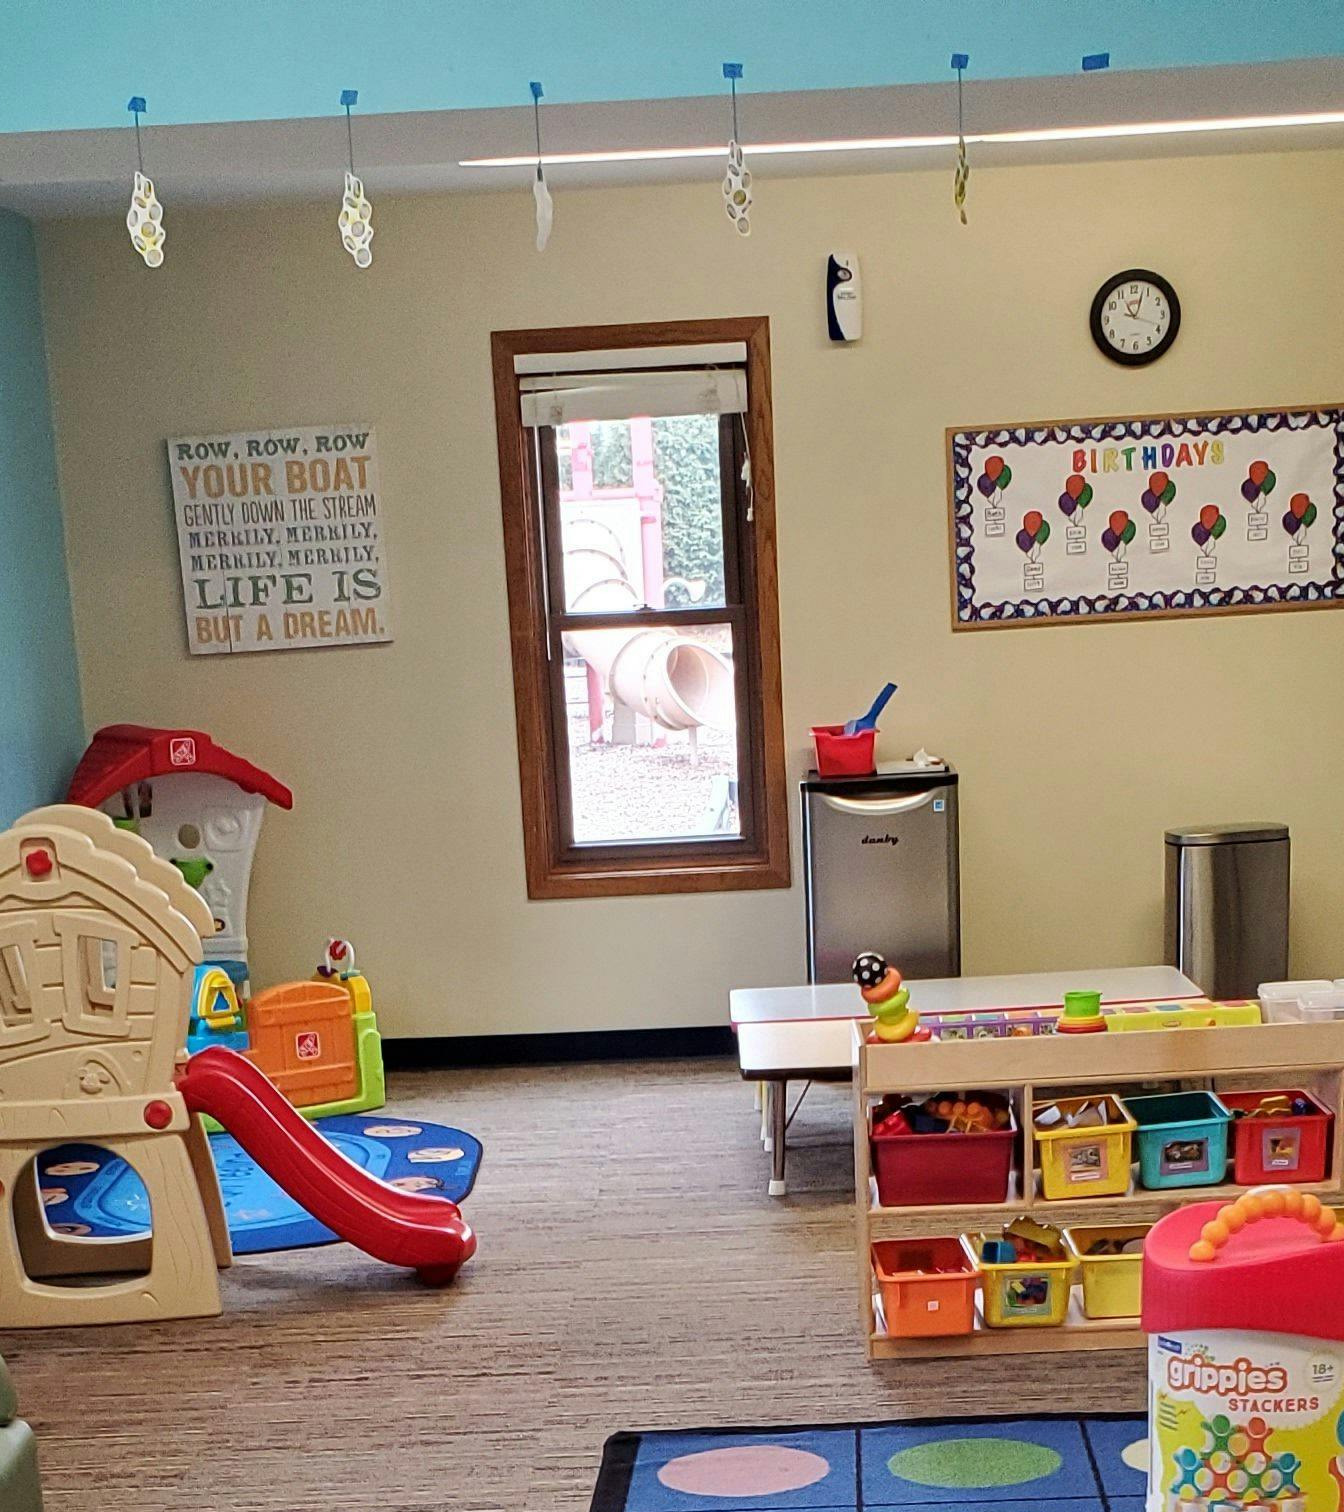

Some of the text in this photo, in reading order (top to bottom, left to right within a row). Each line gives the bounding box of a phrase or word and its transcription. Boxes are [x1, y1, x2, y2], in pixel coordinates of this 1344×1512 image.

[176, 432, 369, 461] ROW, ROW, ROW
[1072, 440, 1225, 473] BIRTHDAYS
[180, 456, 371, 499] YOUR BOAT
[183, 494, 376, 527] GENTLY DOWN THE STREAM
[193, 568, 381, 609] LIFE IS
[195, 607, 384, 644] BUT A DREAM.
[862, 834, 899, 846] danby
[1169, 1355, 1286, 1395] grippies
[1312, 1363, 1334, 1375] 18+
[1228, 1397, 1319, 1412] STACKERS
